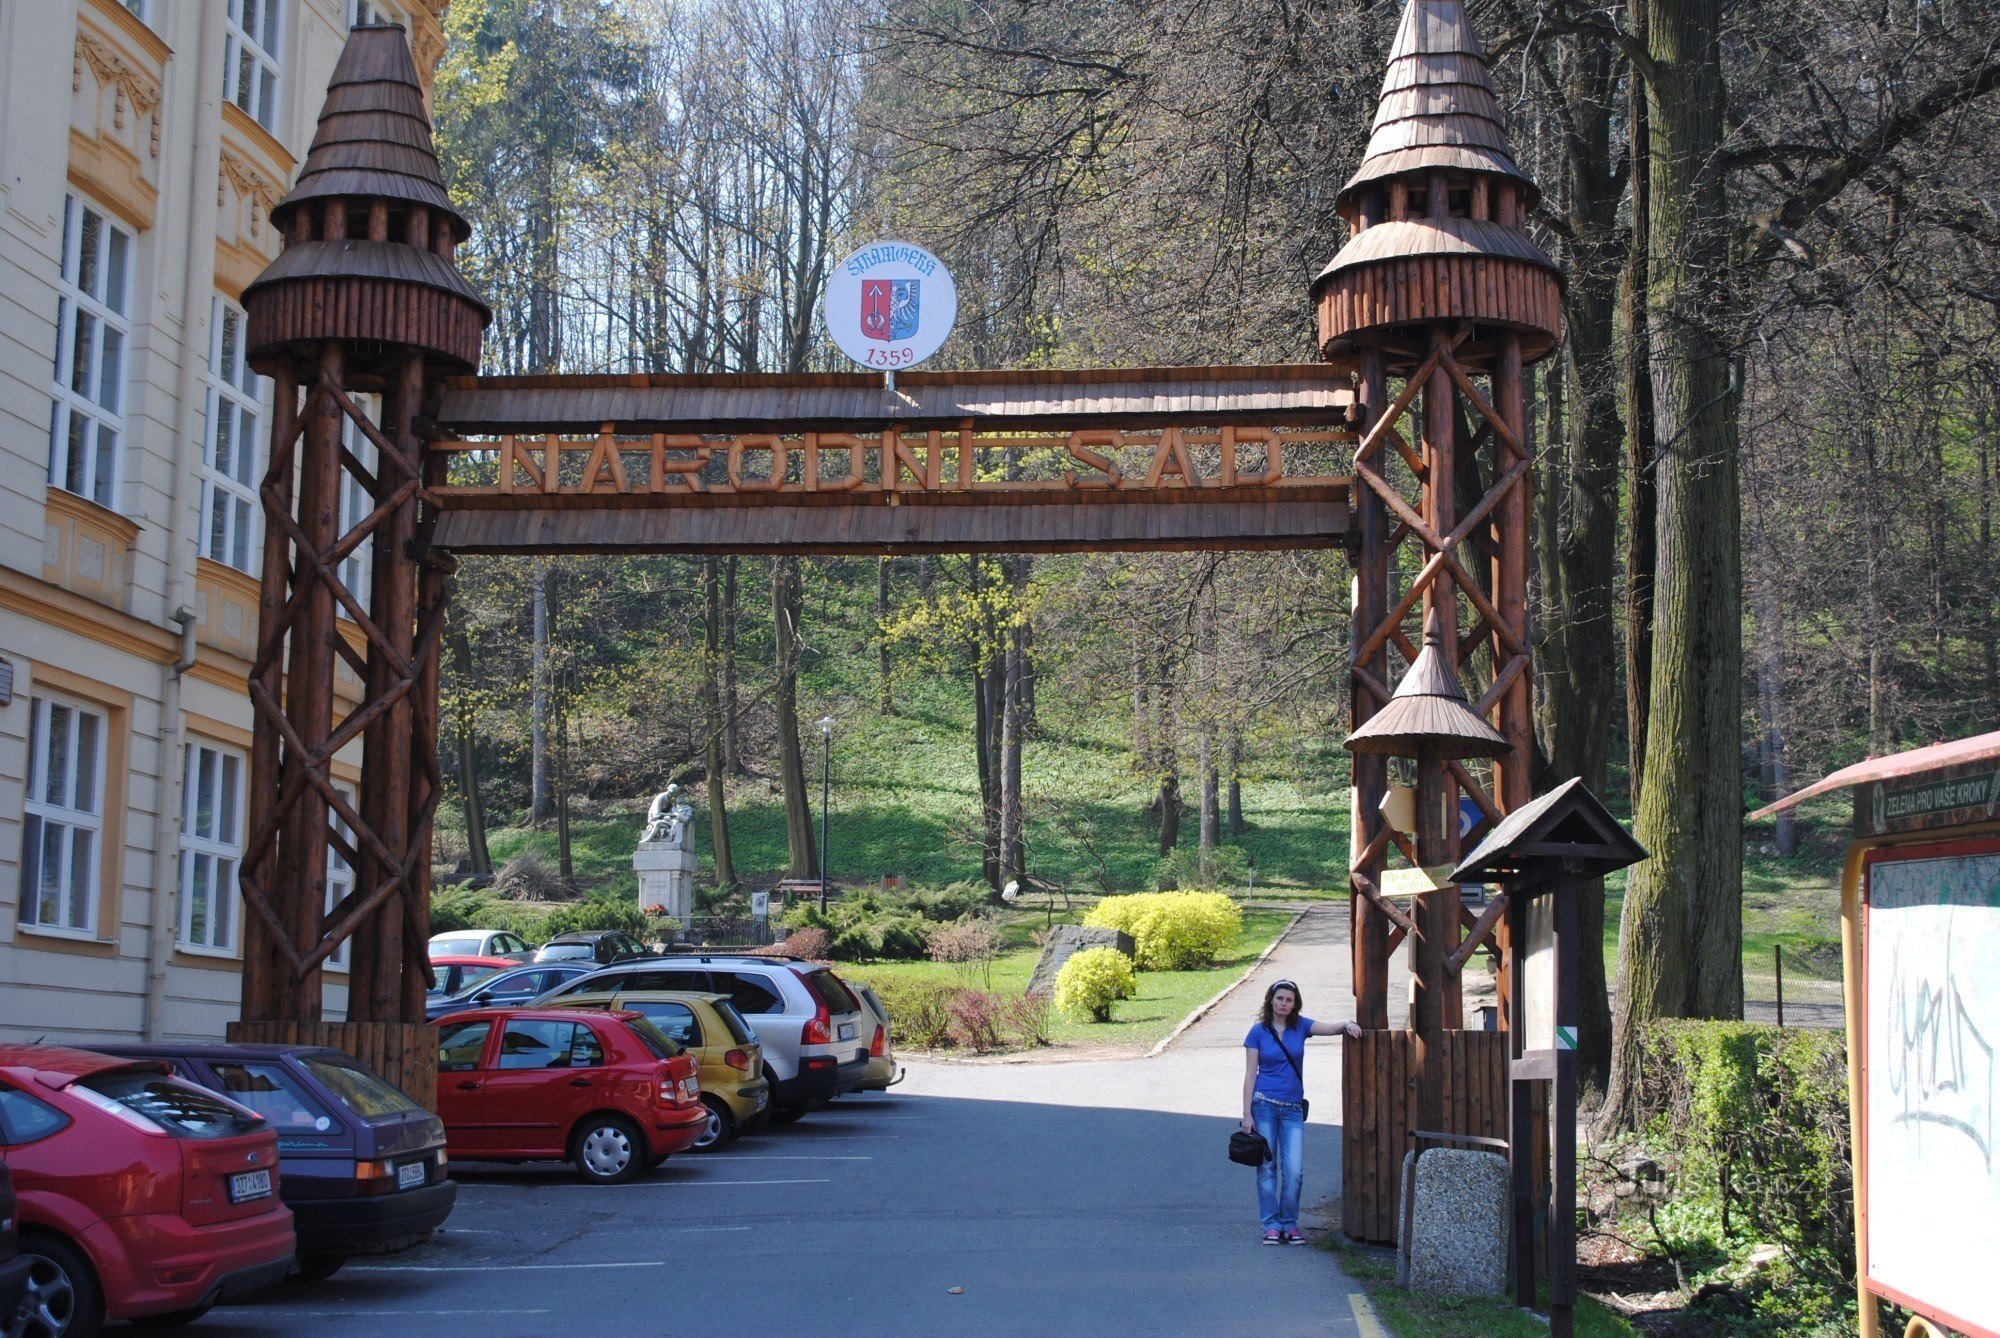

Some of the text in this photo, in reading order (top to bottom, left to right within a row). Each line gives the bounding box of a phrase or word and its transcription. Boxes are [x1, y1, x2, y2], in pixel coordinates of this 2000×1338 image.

[864, 347, 914, 367] 1359
[1064, 426, 1283, 490] SAD
[1886, 779, 1988, 816] ZELENÁ PRO VAŠE KROKY
